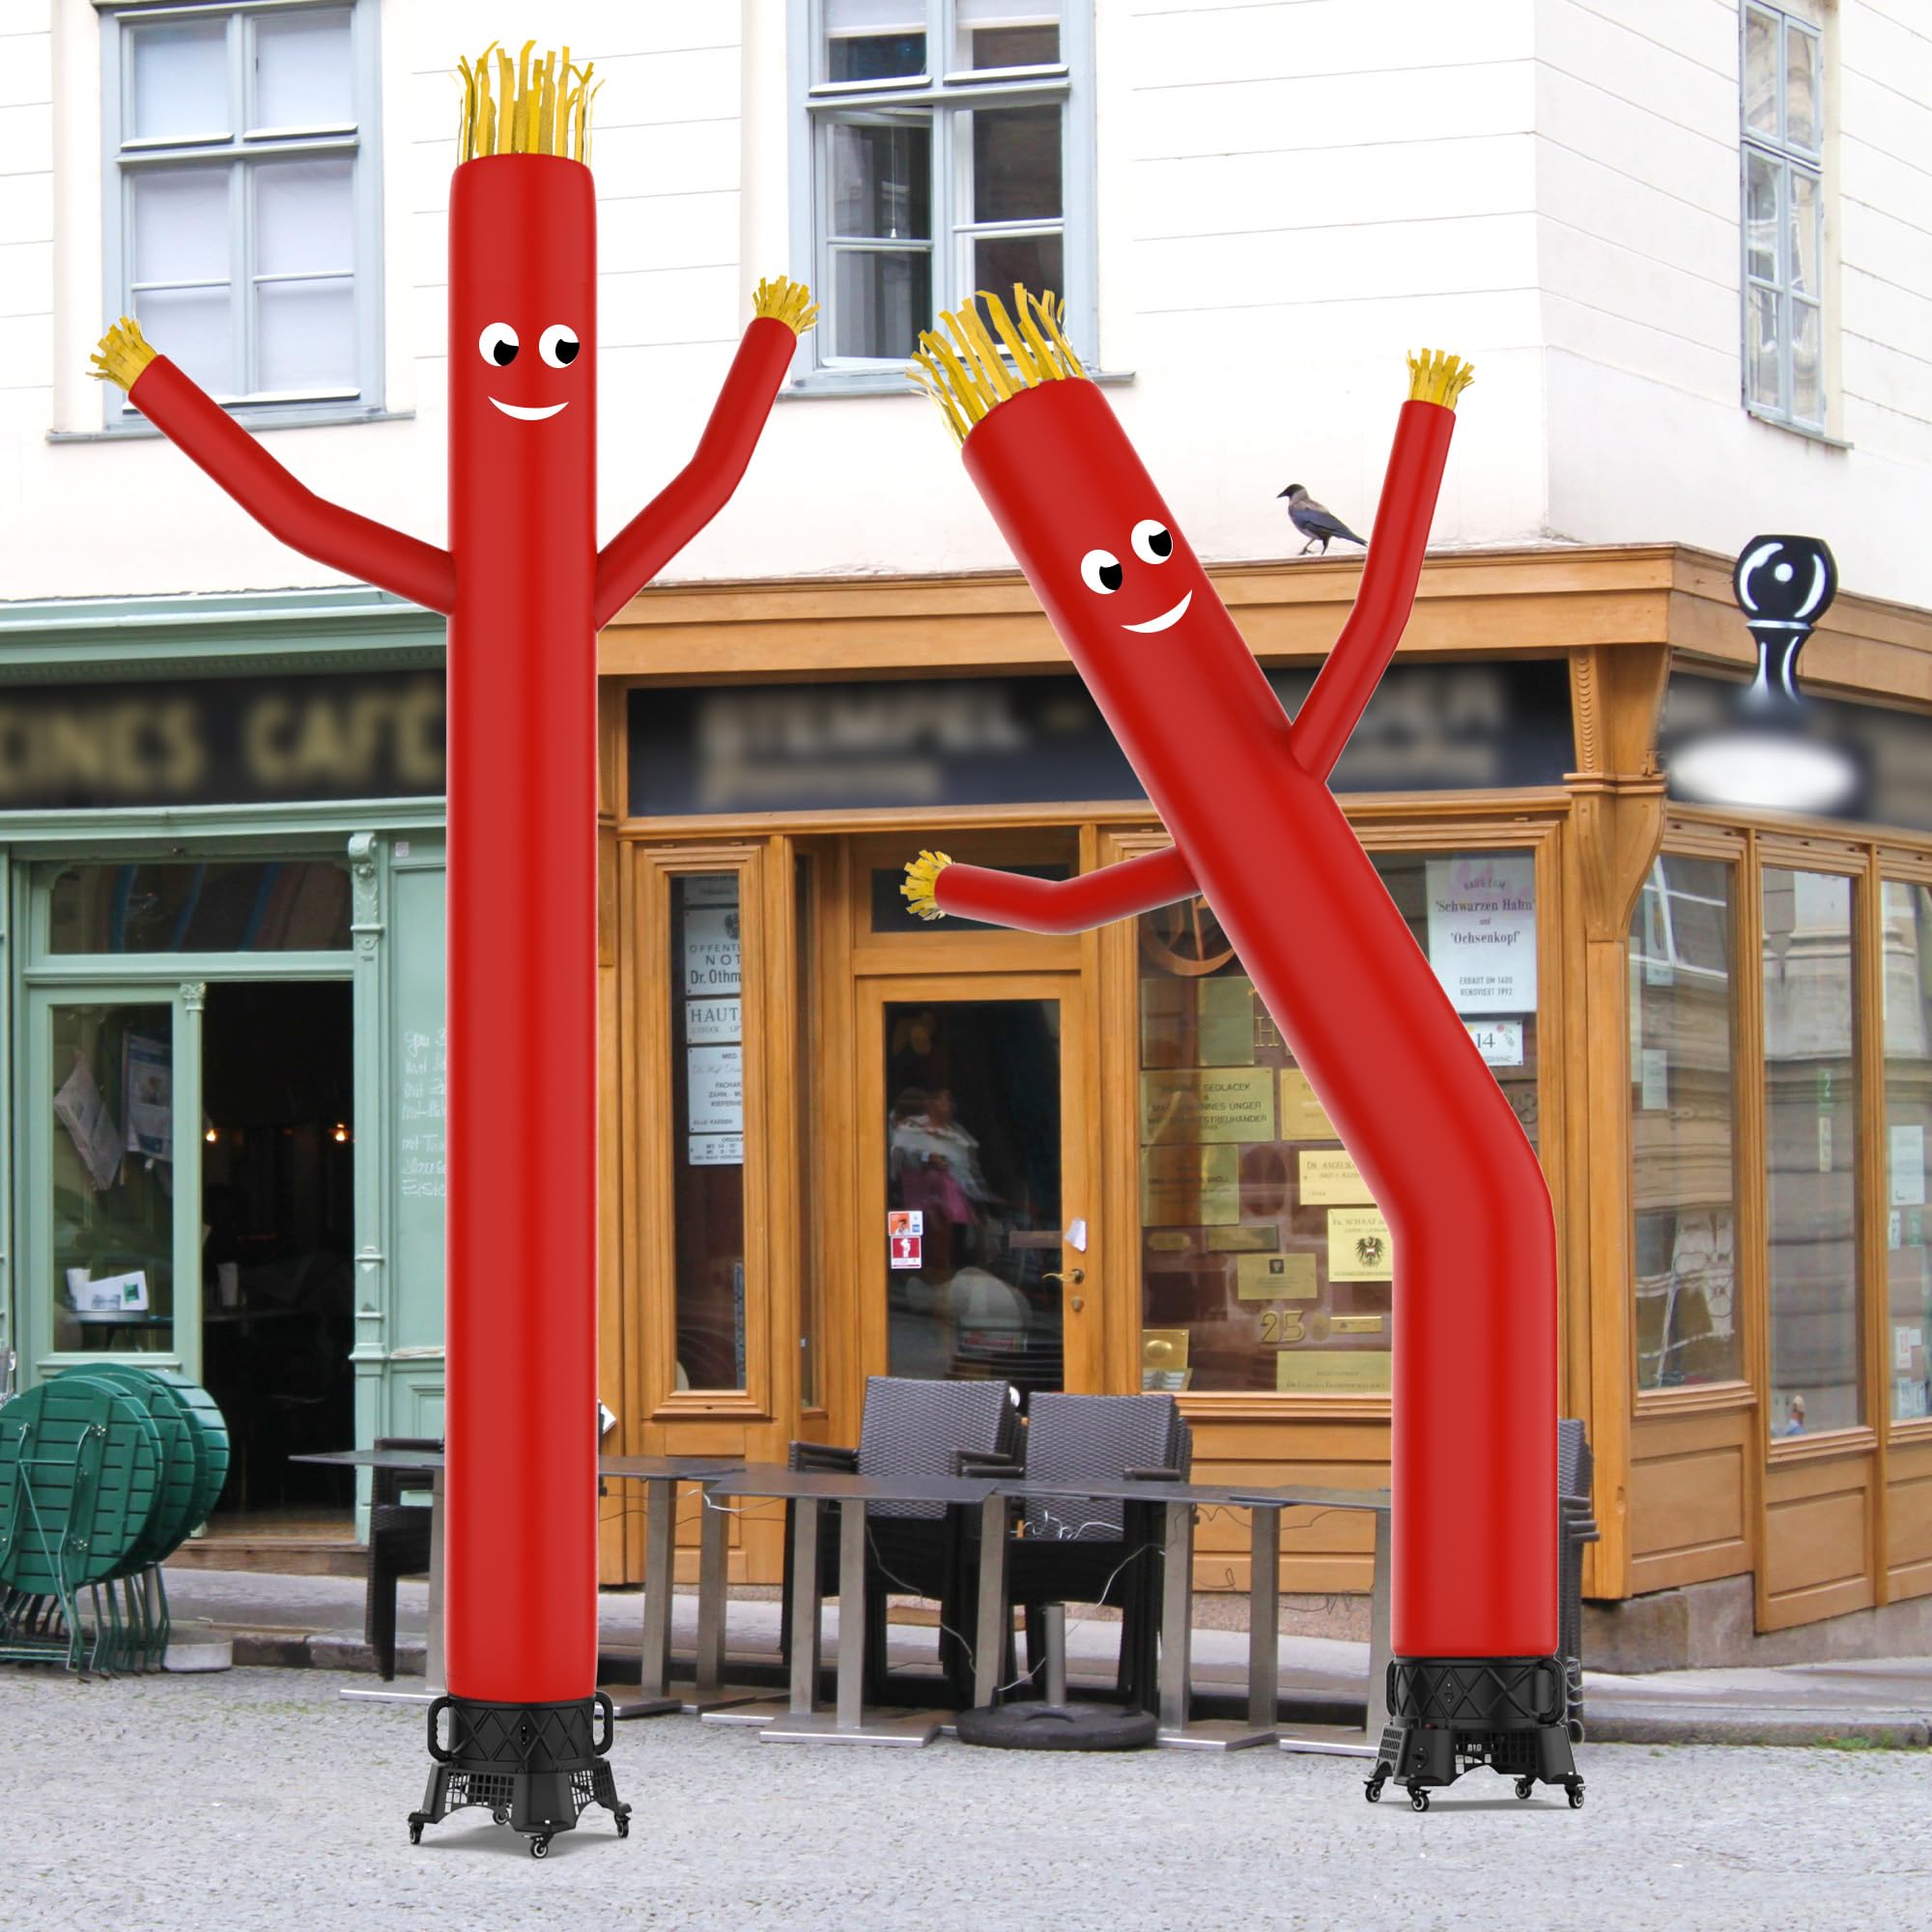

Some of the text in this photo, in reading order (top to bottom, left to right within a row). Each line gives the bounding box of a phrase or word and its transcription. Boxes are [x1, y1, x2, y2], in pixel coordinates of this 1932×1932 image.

[691, 969, 706, 984] Dr.
[1205, 1082, 1251, 1093] SEDLACEK
[1230, 1101, 1262, 1111] UNGER
